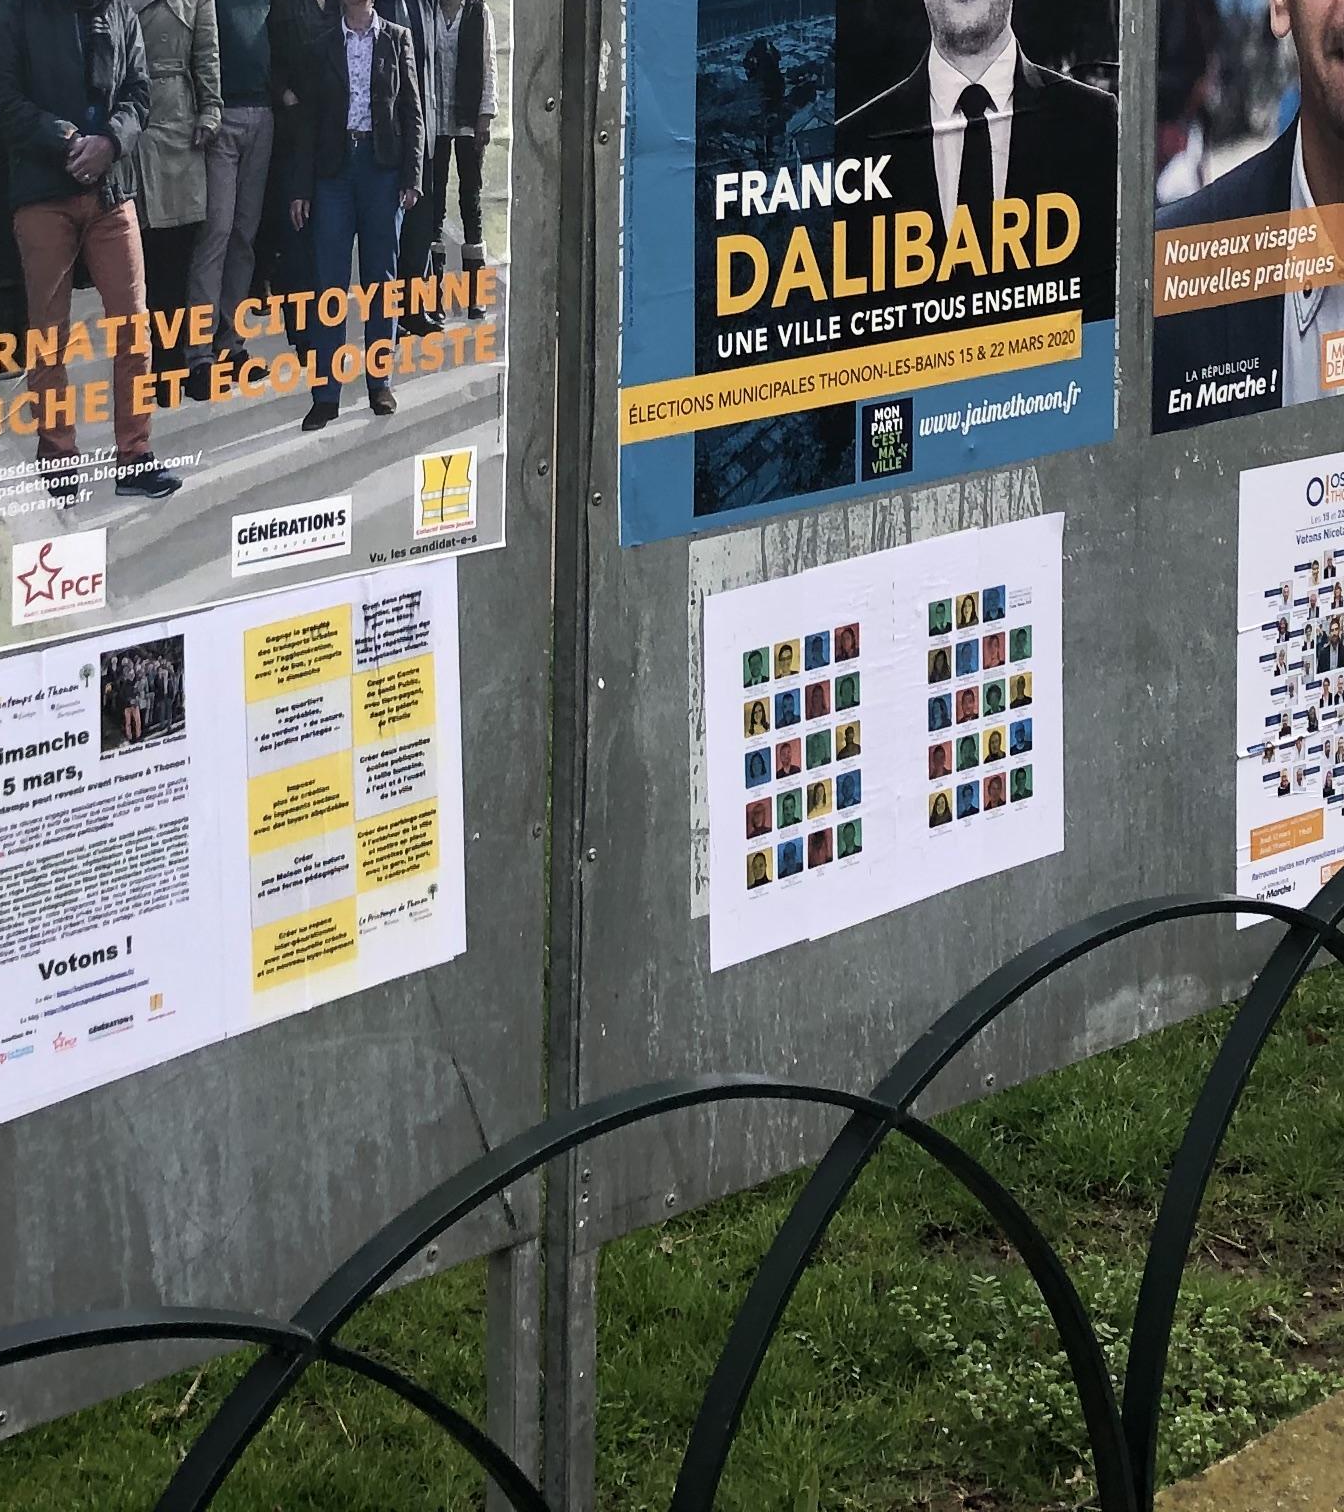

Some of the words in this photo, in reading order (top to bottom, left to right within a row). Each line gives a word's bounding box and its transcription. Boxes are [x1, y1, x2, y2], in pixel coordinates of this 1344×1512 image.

[715, 155, 893, 220] FRANCK
[716, 193, 1081, 317] DALIBARD
[1164, 231, 1250, 265] Nouveaux
[1254, 223, 1317, 256] visages
[1164, 269, 1251, 302] Nouvelles
[1255, 252, 1335, 292] pratiques
[234, 268, 497, 341] CITOYENNE
[718, 327, 767, 358] UNE
[777, 315, 841, 349] VILLE
[851, 304, 905, 336] C'EST
[913, 294, 967, 326] TOUS
[972, 277, 1082, 318] ENSEMBLE
[132, 365, 190, 418] ET
[210, 323, 497, 410] ÉCOLOGISTE
[629, 393, 714, 426] ÉLECTIONS
[718, 375, 816, 409] MUNICIPALES
[819, 351, 956, 391] THONON-LES-BAINS
[1007, 334, 1044, 357] MARS
[1047, 329, 1076, 350] 2020
[1202, 356, 1260, 379] RÉPUBLIQUE
[874, 405, 900, 420] MON
[919, 380, 1082, 439] www.jaimethonon.fr
[1168, 389, 1192, 414] En
[1196, 375, 1267, 407] Marche
[871, 417, 903, 434] PARTI
[871, 456, 902, 474] VILLE
[410, 534, 478, 556] candidat-e-s
[61, 573, 103, 599] PCF
[39, 944, 118, 980] Votons
